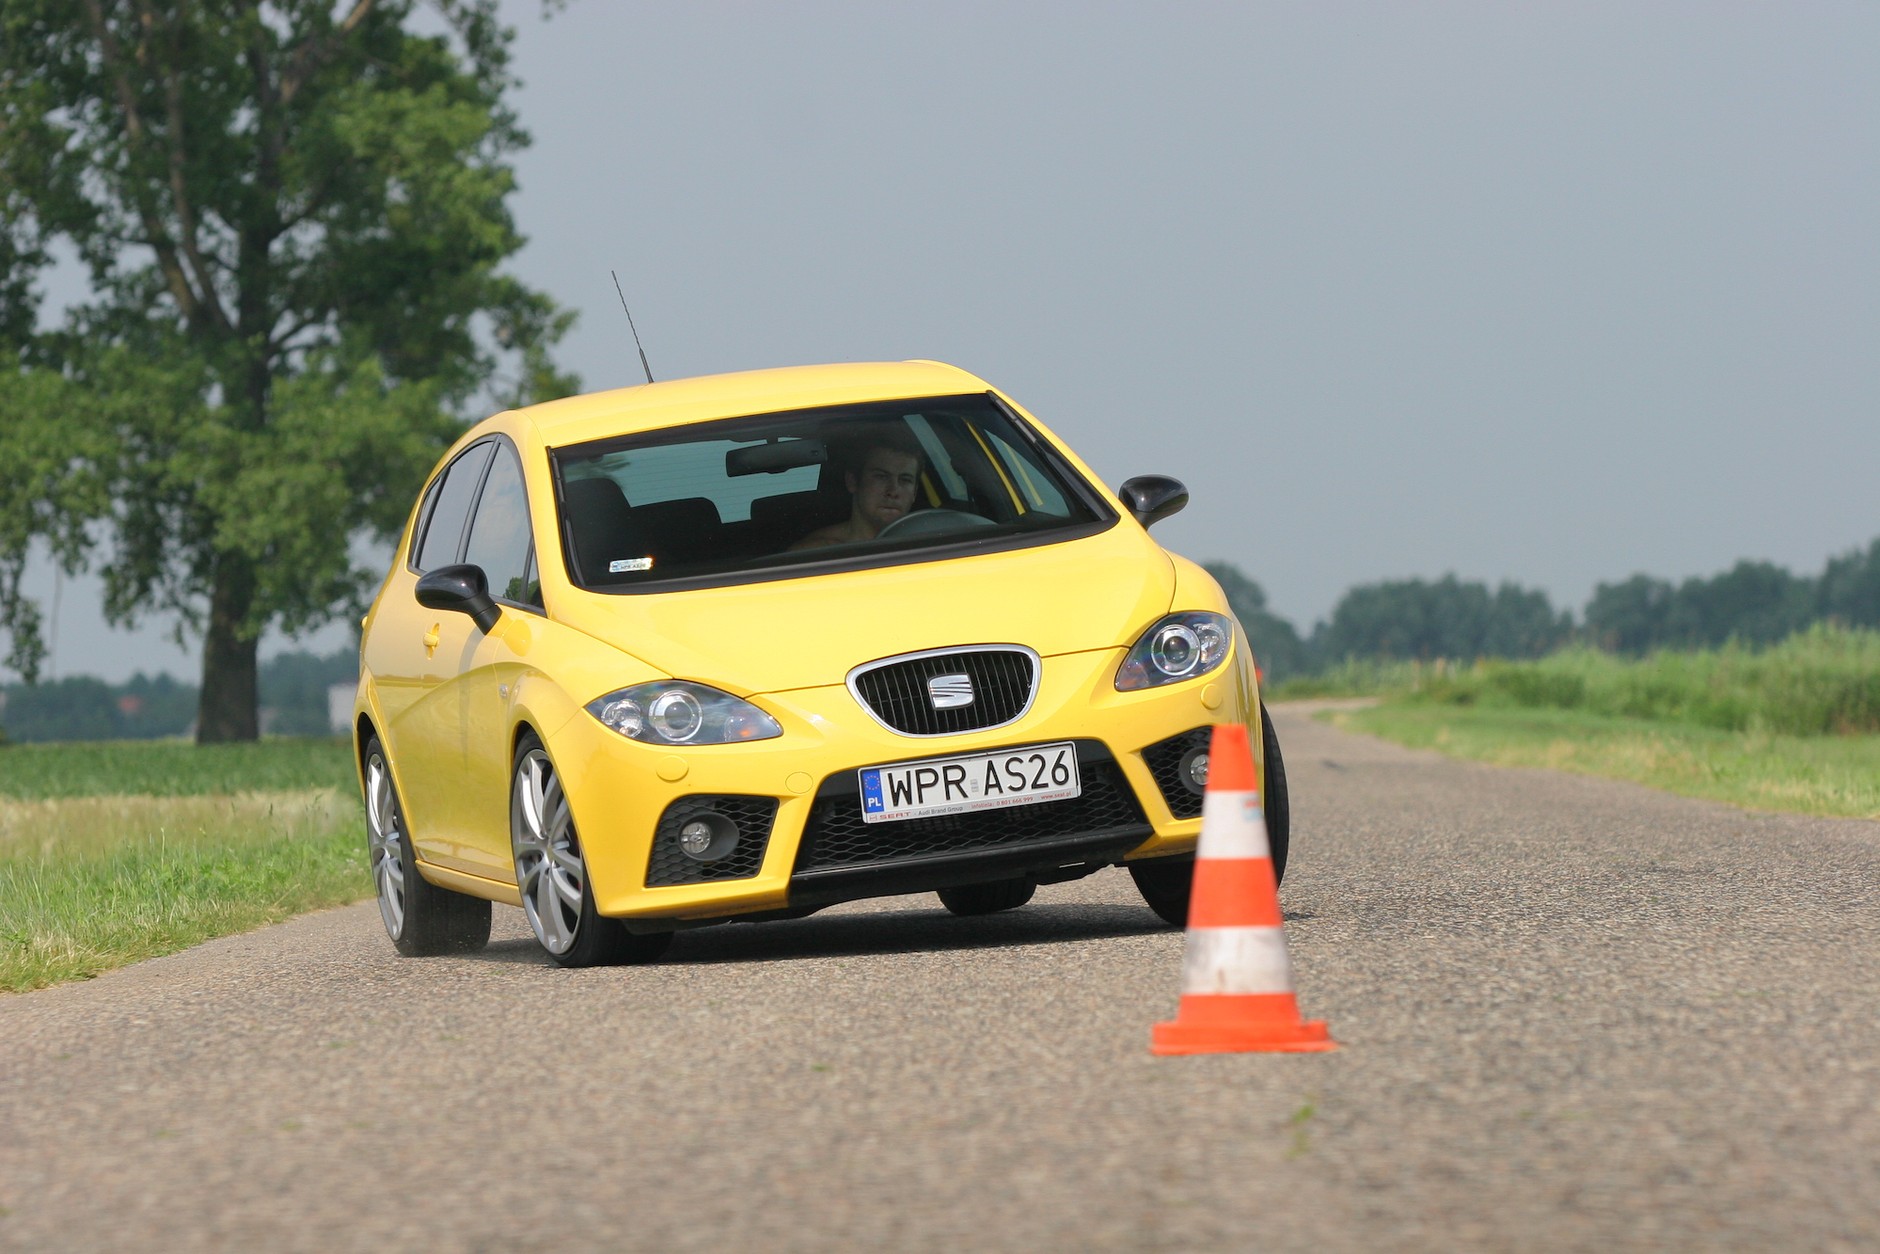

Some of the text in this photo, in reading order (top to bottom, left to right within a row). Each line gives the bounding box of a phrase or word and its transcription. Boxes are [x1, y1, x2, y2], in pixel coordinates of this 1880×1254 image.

[887, 750, 1070, 807] WPR AS26
[868, 797, 881, 807] PL
[880, 811, 911, 819] SEAT
[931, 807, 947, 815] Brand
